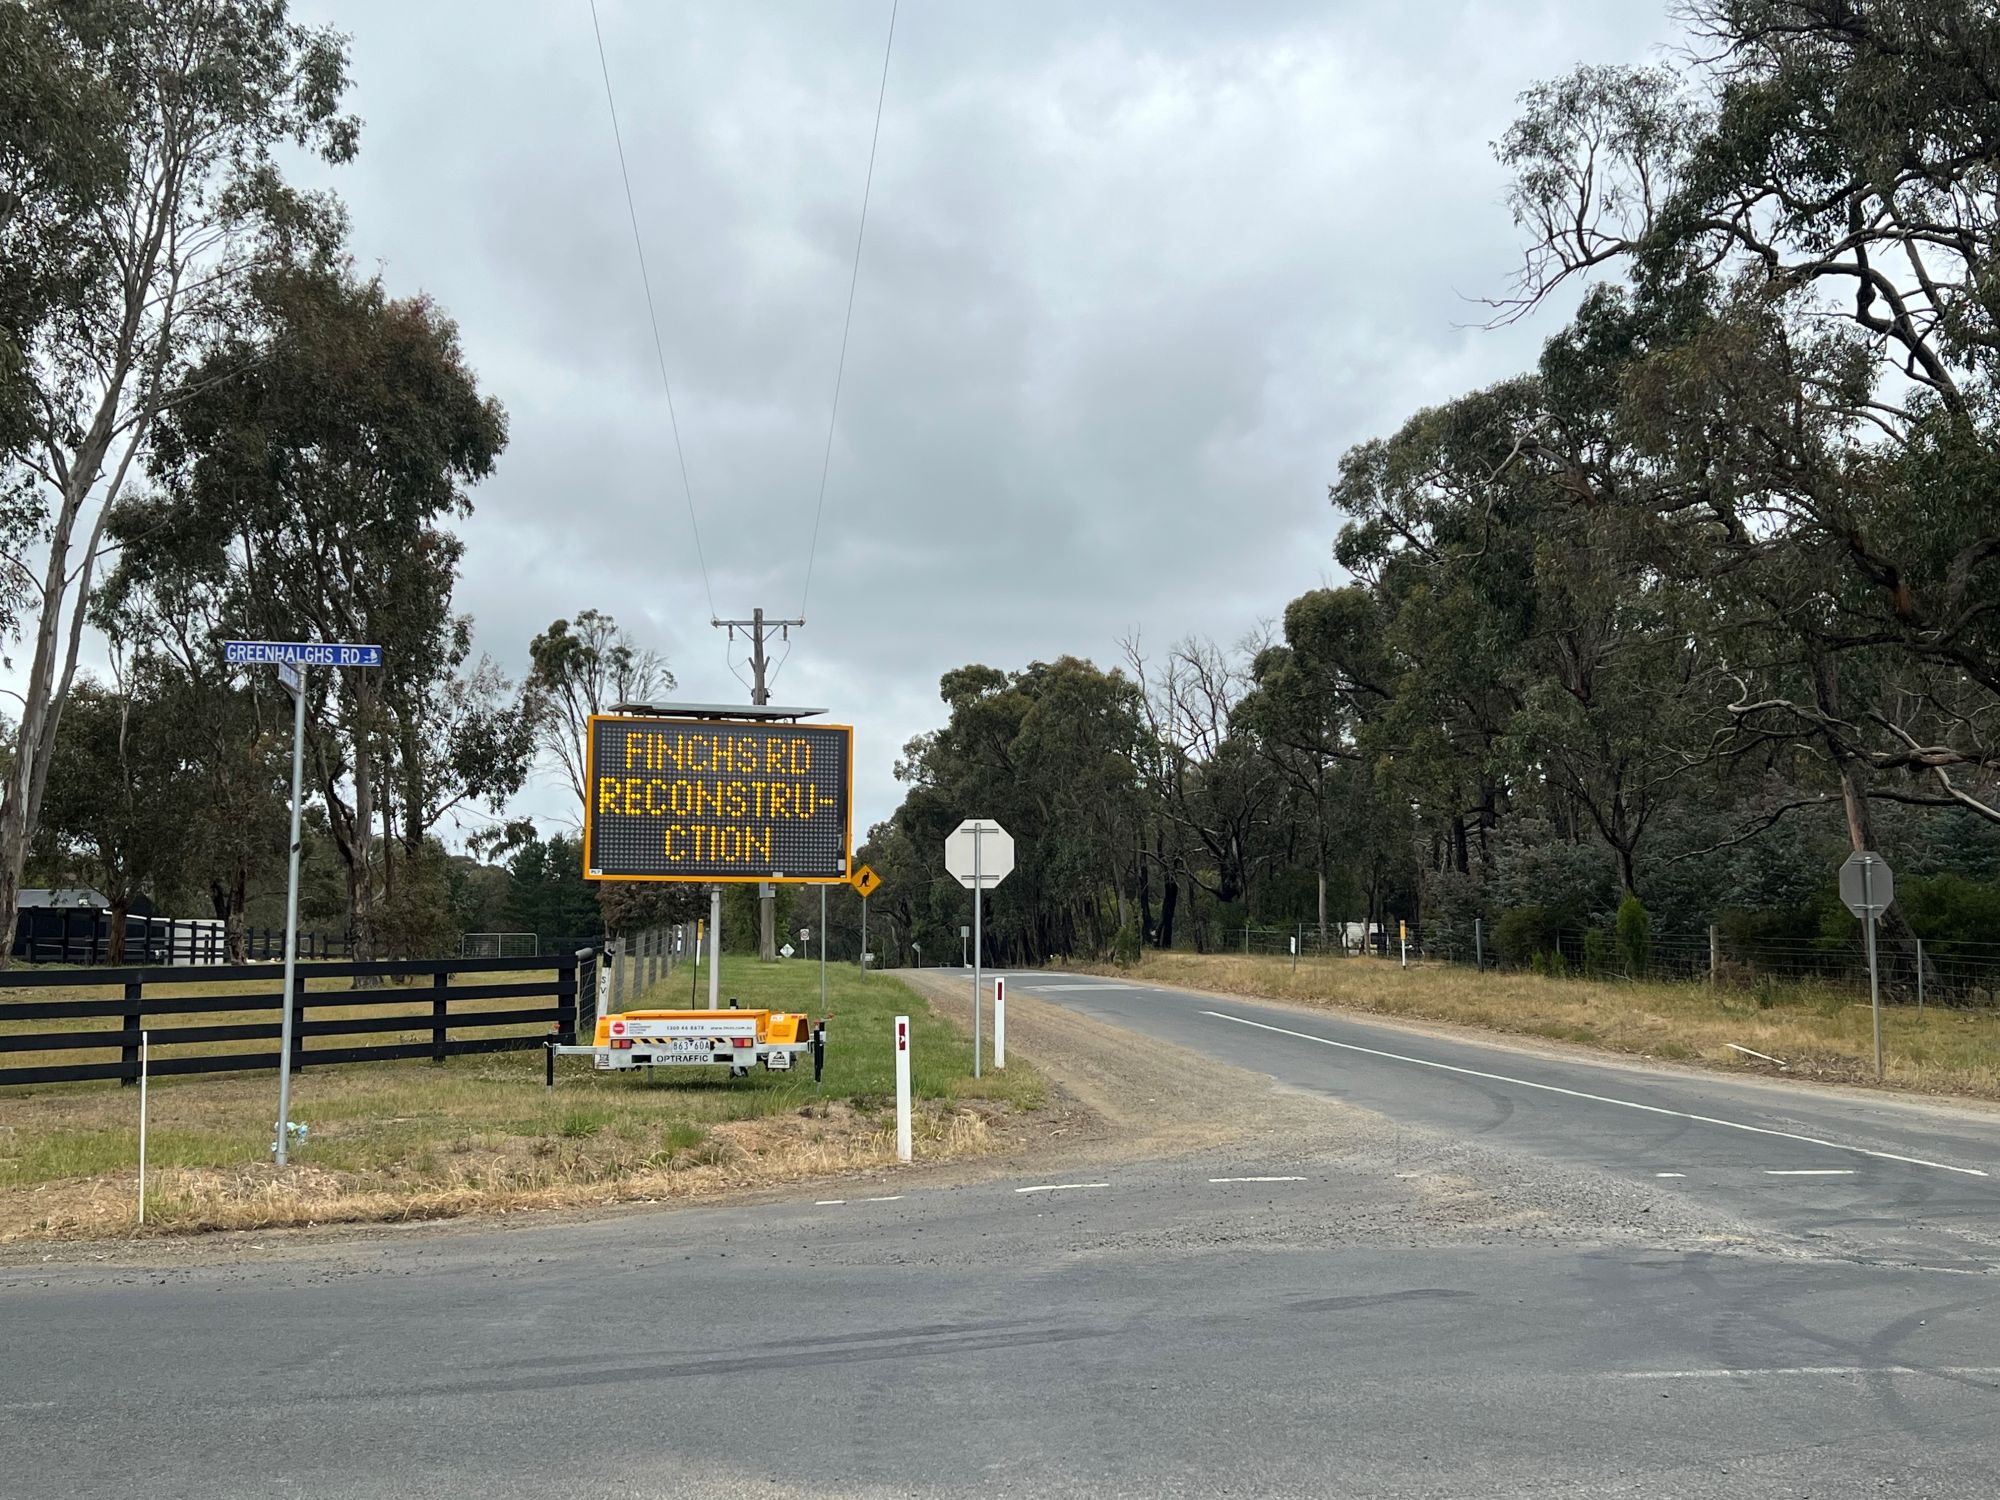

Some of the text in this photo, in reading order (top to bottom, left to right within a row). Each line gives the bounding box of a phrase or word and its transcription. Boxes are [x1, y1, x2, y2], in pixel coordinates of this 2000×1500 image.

[227, 645, 360, 664] GREENHALGHS RD
[625, 732, 811, 775] FINCHS RD
[598, 777, 835, 819] RECONSTRU-
[664, 824, 771, 863] CTION
[656, 1055, 709, 1063] OPTRAFFIC
